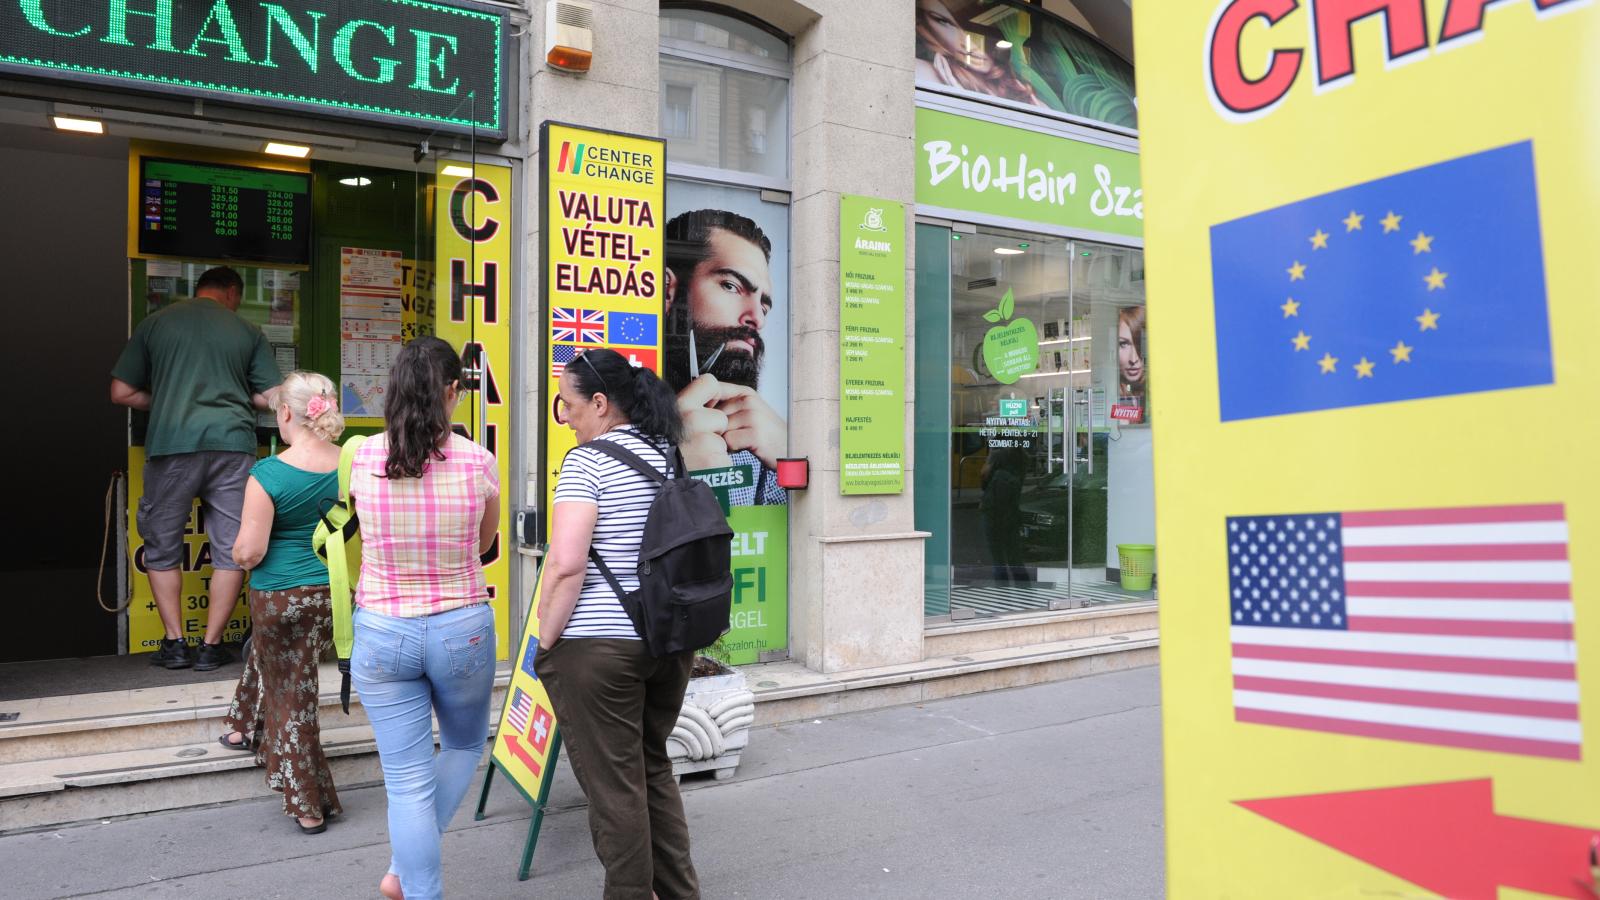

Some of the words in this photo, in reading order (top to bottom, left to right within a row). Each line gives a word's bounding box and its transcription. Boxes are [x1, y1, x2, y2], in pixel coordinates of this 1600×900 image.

[18, 0, 460, 95] CHANGE
[587, 146, 653, 167] CENTER
[585, 163, 654, 185] CHANGE
[558, 190, 655, 228] VALUTA
[562, 222, 650, 262] VÉTEL-
[854, 236, 892, 253] ÁRAINK
[556, 263, 656, 298] ELADÁS
[986, 417, 1006, 426] NYITVA
[1113, 406, 1139, 418] NYITVA
[690, 468, 745, 488] KEZÉS
